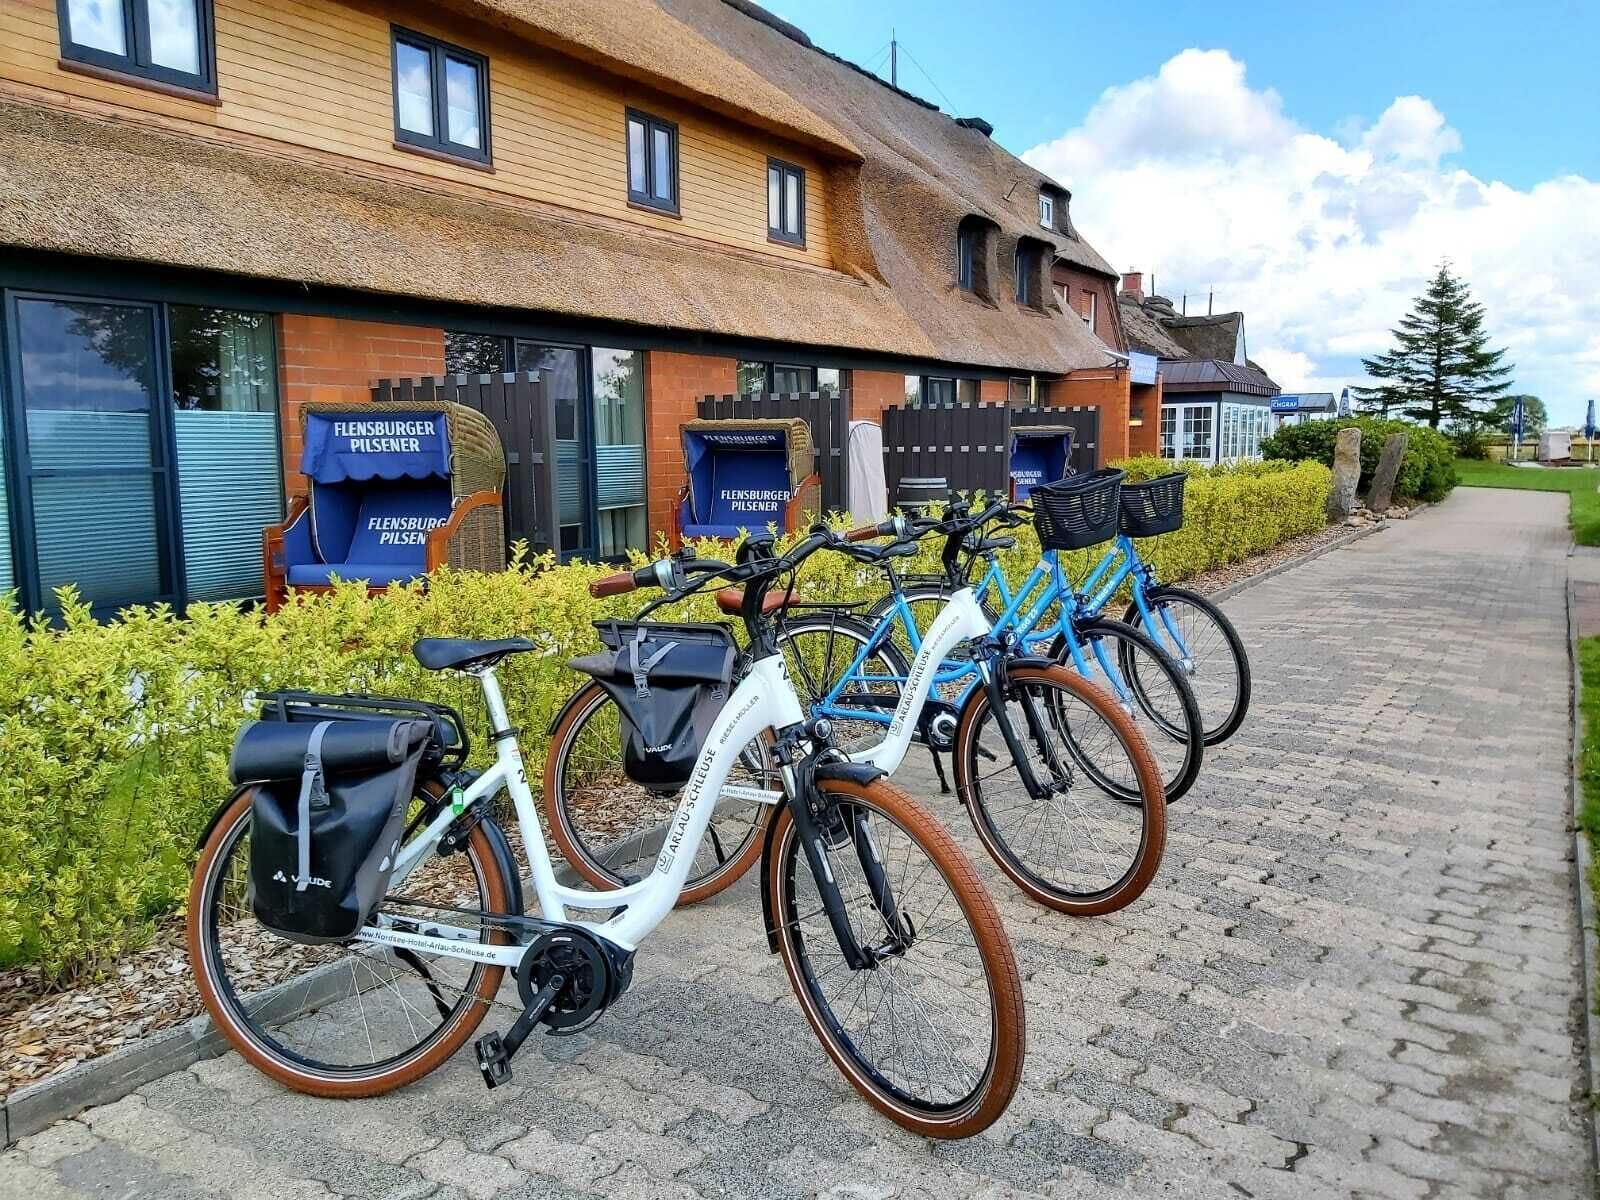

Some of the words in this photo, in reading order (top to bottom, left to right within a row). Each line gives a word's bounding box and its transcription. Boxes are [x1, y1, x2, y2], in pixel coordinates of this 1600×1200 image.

[334, 421, 436, 437] FLENSBURGER
[350, 438, 421, 453] PILSENER
[721, 489, 791, 501] FLENSBURGER
[731, 501, 778, 512] PILSENER
[899, 649, 931, 722] ARLAU-SCHLEUSE
[517, 769, 527, 784] 2
[670, 748, 716, 854] ARLAU-SCHLEUSE
[291, 875, 332, 888] VUDE
